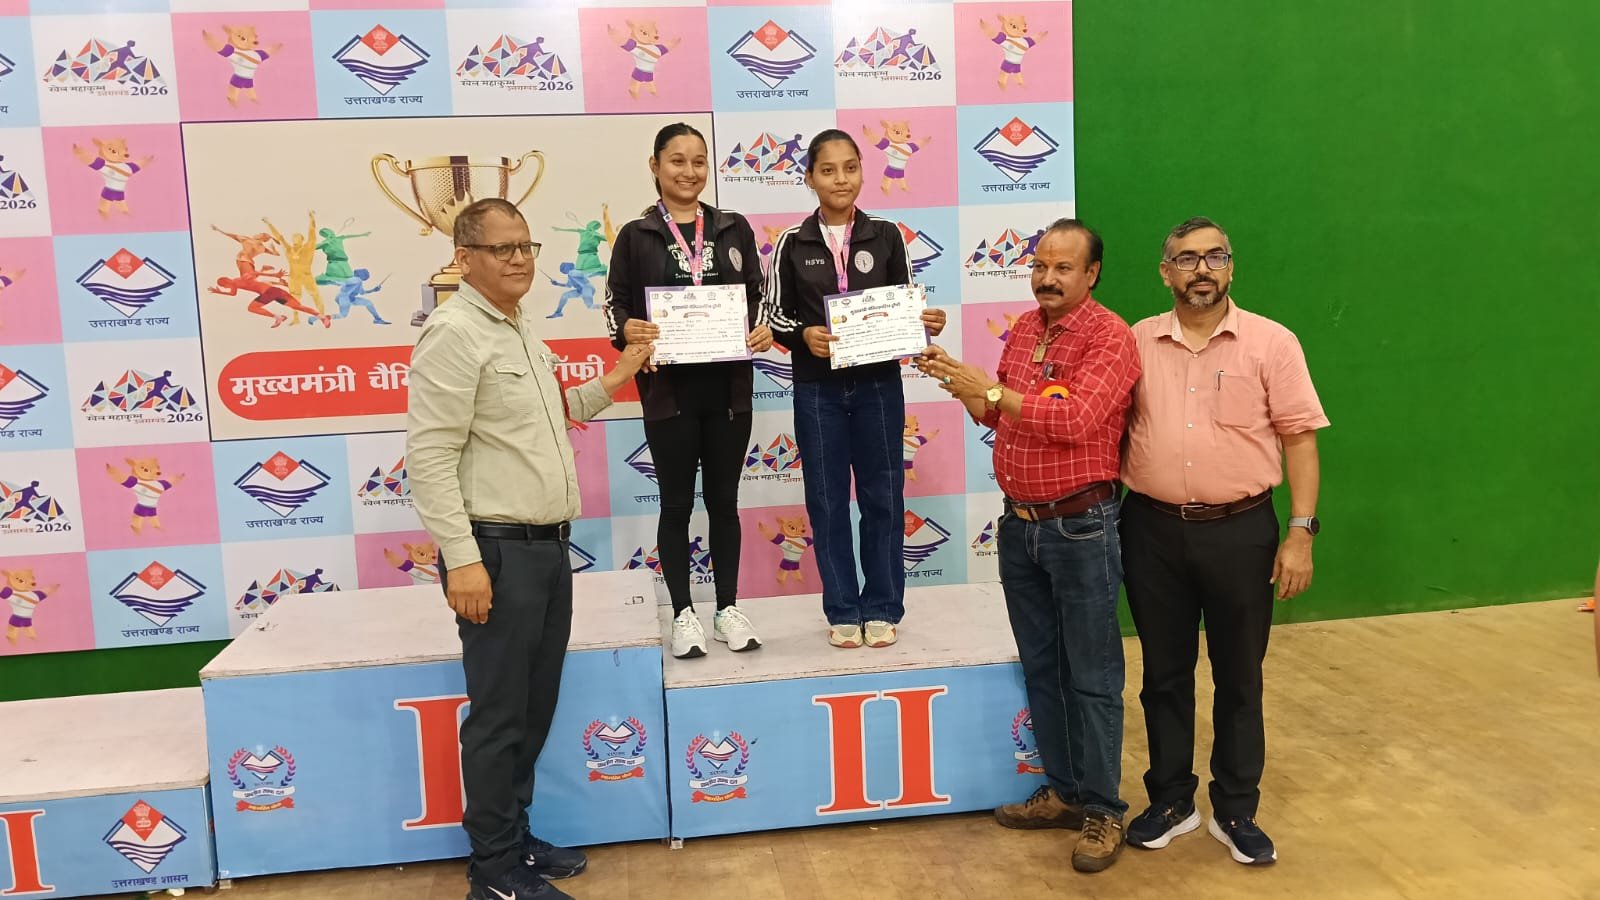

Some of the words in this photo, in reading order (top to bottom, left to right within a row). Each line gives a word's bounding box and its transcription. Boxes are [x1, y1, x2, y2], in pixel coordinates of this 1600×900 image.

[909, 71, 942, 81] 2026
[130, 85, 168, 96] 2026
[538, 80, 574, 91] 2026
[736, 90, 784, 99] उत्तराखण्ड
[787, 88, 808, 98] राज्य
[344, 96, 396, 105] उत्तराखण्ड
[400, 95, 423, 104] राज्य
[982, 183, 1028, 193] उत्तराखण्ड
[1030, 182, 1050, 191] राज्य
[0, 199, 37, 210] 2026
[88, 318, 141, 329] उत्तराखण्ड
[144, 316, 170, 326] राज्य
[229, 365, 356, 406] मुख्यमंत्री
[167, 412, 203, 424] 2026
[17, 429, 43, 438] राज्य
[35, 522, 72, 533] 2026
[246, 518, 297, 529] उत्तराखण्ड
[300, 515, 324, 526] राज्य
[921, 569, 943, 578] राज्य
[121, 627, 173, 638] उत्तराखण्ड
[177, 625, 200, 635] राज्य
[813, 686, 950, 814] II
[395, 695, 471, 829] I
[112, 876, 157, 889] उत्तराखण्ड
[161, 873, 189, 886] शासन
